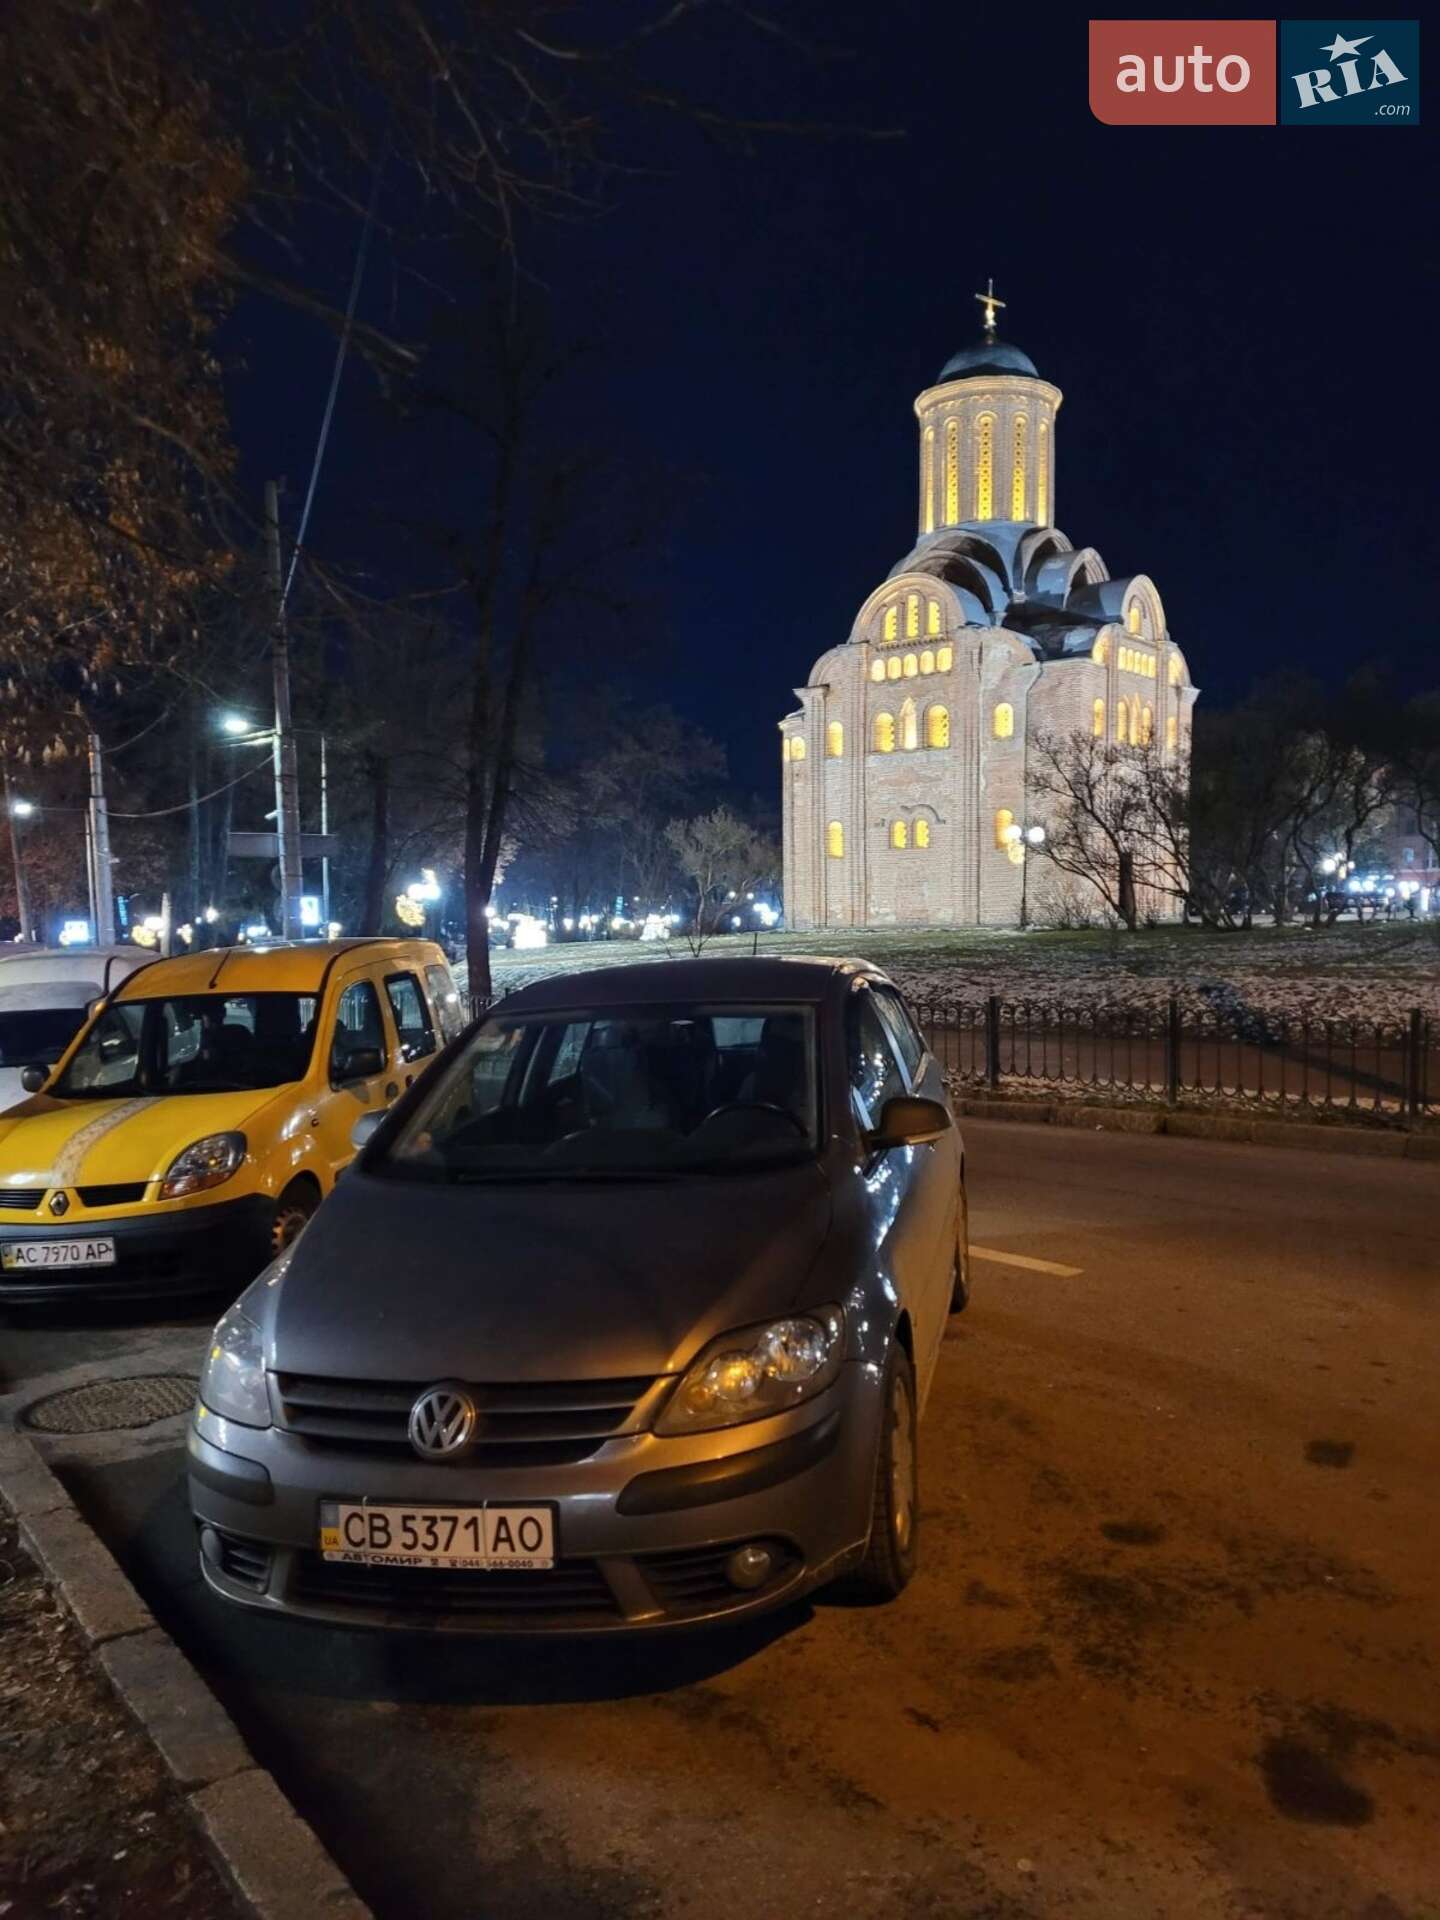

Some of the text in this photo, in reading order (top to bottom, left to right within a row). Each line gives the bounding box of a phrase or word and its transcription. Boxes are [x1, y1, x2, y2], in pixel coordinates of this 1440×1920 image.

[16, 1242, 112, 1263] AC 7970 AP
[324, 1536, 339, 1546] UA
[344, 1512, 543, 1552] CB 5371 AO
